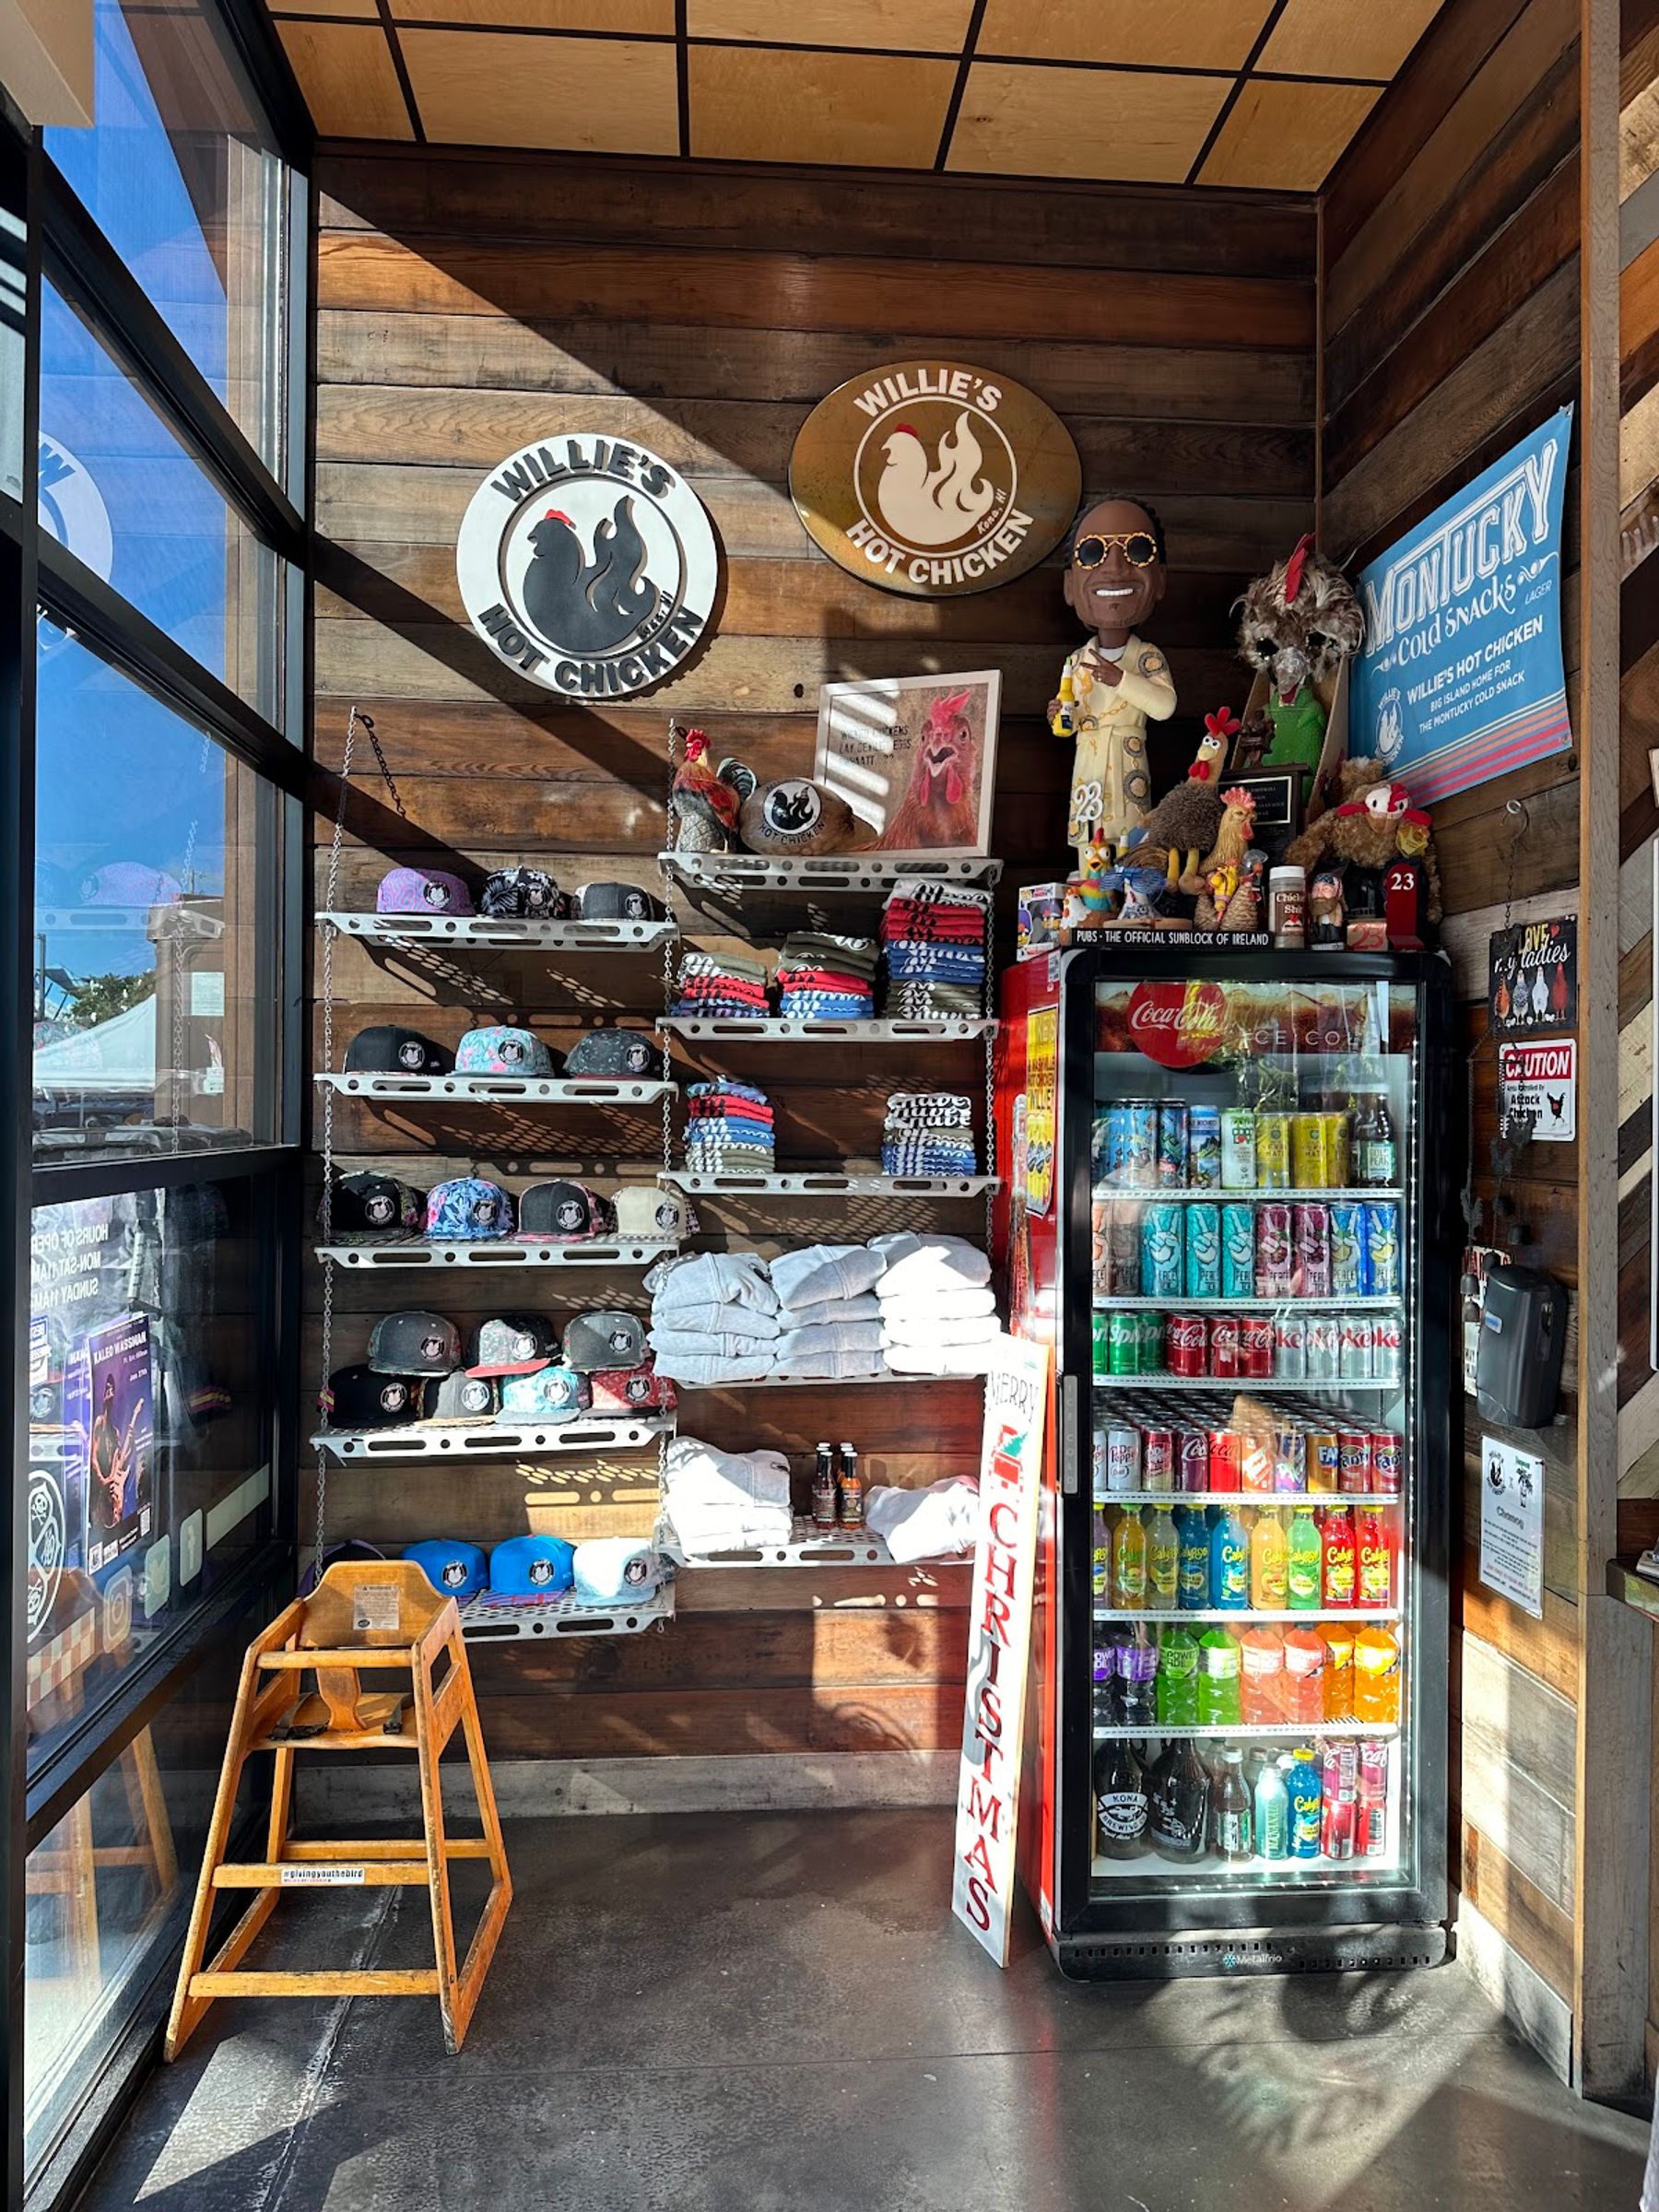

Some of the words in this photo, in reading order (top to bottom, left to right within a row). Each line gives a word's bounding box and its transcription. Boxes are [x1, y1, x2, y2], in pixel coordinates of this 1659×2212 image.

[853, 368, 1004, 418] WILLIE'S
[490, 438, 677, 502] WILLIE'S
[845, 517, 907, 575] HOT
[907, 508, 1035, 586] CHICKEN
[1365, 438, 1558, 657] MONTUCKY
[1524, 579, 1553, 606] LAGER
[477, 602, 551, 675] HOT
[553, 605, 708, 698] CHICKEN
[1406, 668, 1455, 706] WILLIE'S
[1456, 654, 1485, 682] HOT
[1484, 614, 1544, 663] CHICKEN
[1418, 720, 1433, 735] THE
[1433, 698, 1475, 727] MONTUCKY
[1475, 687, 1495, 706] COLD
[1496, 670, 1525, 693] SNACK
[1430, 698, 1442, 712] BIG
[1443, 682, 1472, 704] ISLAND
[1472, 671, 1494, 692] HOME
[1493, 661, 1512, 683] FOR
[1074, 781, 1103, 822] 23
[759, 823, 779, 841] HOT
[781, 820, 826, 846] CHICKEN
[1390, 872, 1415, 890] 23
[1076, 930, 1098, 943] PUBS
[1105, 931, 1122, 943] THE
[1124, 931, 1166, 945] OFFICIAL
[1168, 931, 1214, 946] SUNBLOCK
[1216, 933, 1230, 945] OF
[1232, 933, 1269, 946] IRELAND
[1351, 924, 1382, 950] 23
[1520, 934, 1571, 969] ladies
[1505, 1051, 1571, 1078] CAUTION
[967, 1501, 1018, 1932] CHRISTMAS
[1112, 1794, 1138, 1803] KONA
[1102, 1814, 1138, 1831] BREWING
[1235, 1953, 1283, 1965] Metalfrio
